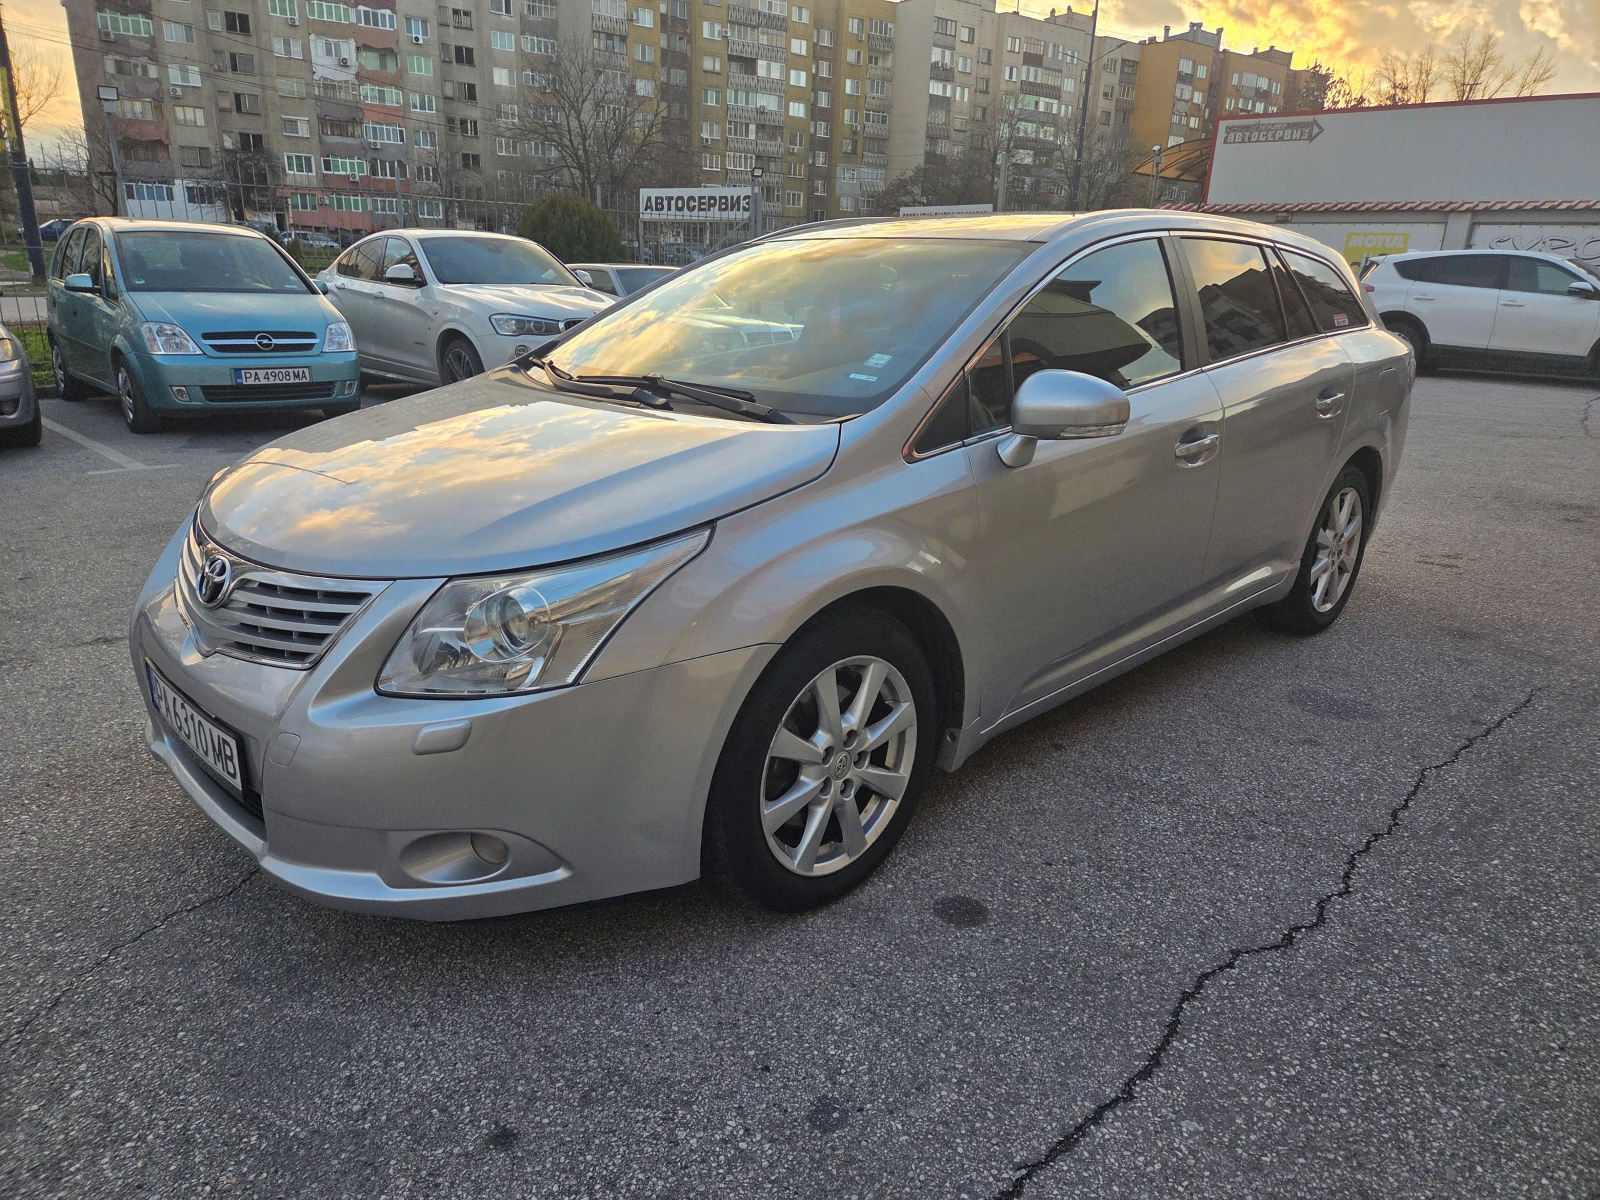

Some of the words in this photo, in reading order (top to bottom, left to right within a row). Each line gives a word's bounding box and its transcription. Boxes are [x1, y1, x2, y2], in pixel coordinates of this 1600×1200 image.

[1227, 128, 1309, 142] АВТОСЕРВИЗ
[644, 195, 752, 212] АВТОСЕРВИЗ
[1347, 235, 1405, 248] MOTUL
[244, 371, 261, 383] PA
[263, 370, 291, 382] 4908
[292, 369, 308, 381] MA
[172, 696, 209, 757] 6310
[209, 727, 237, 780] MB
